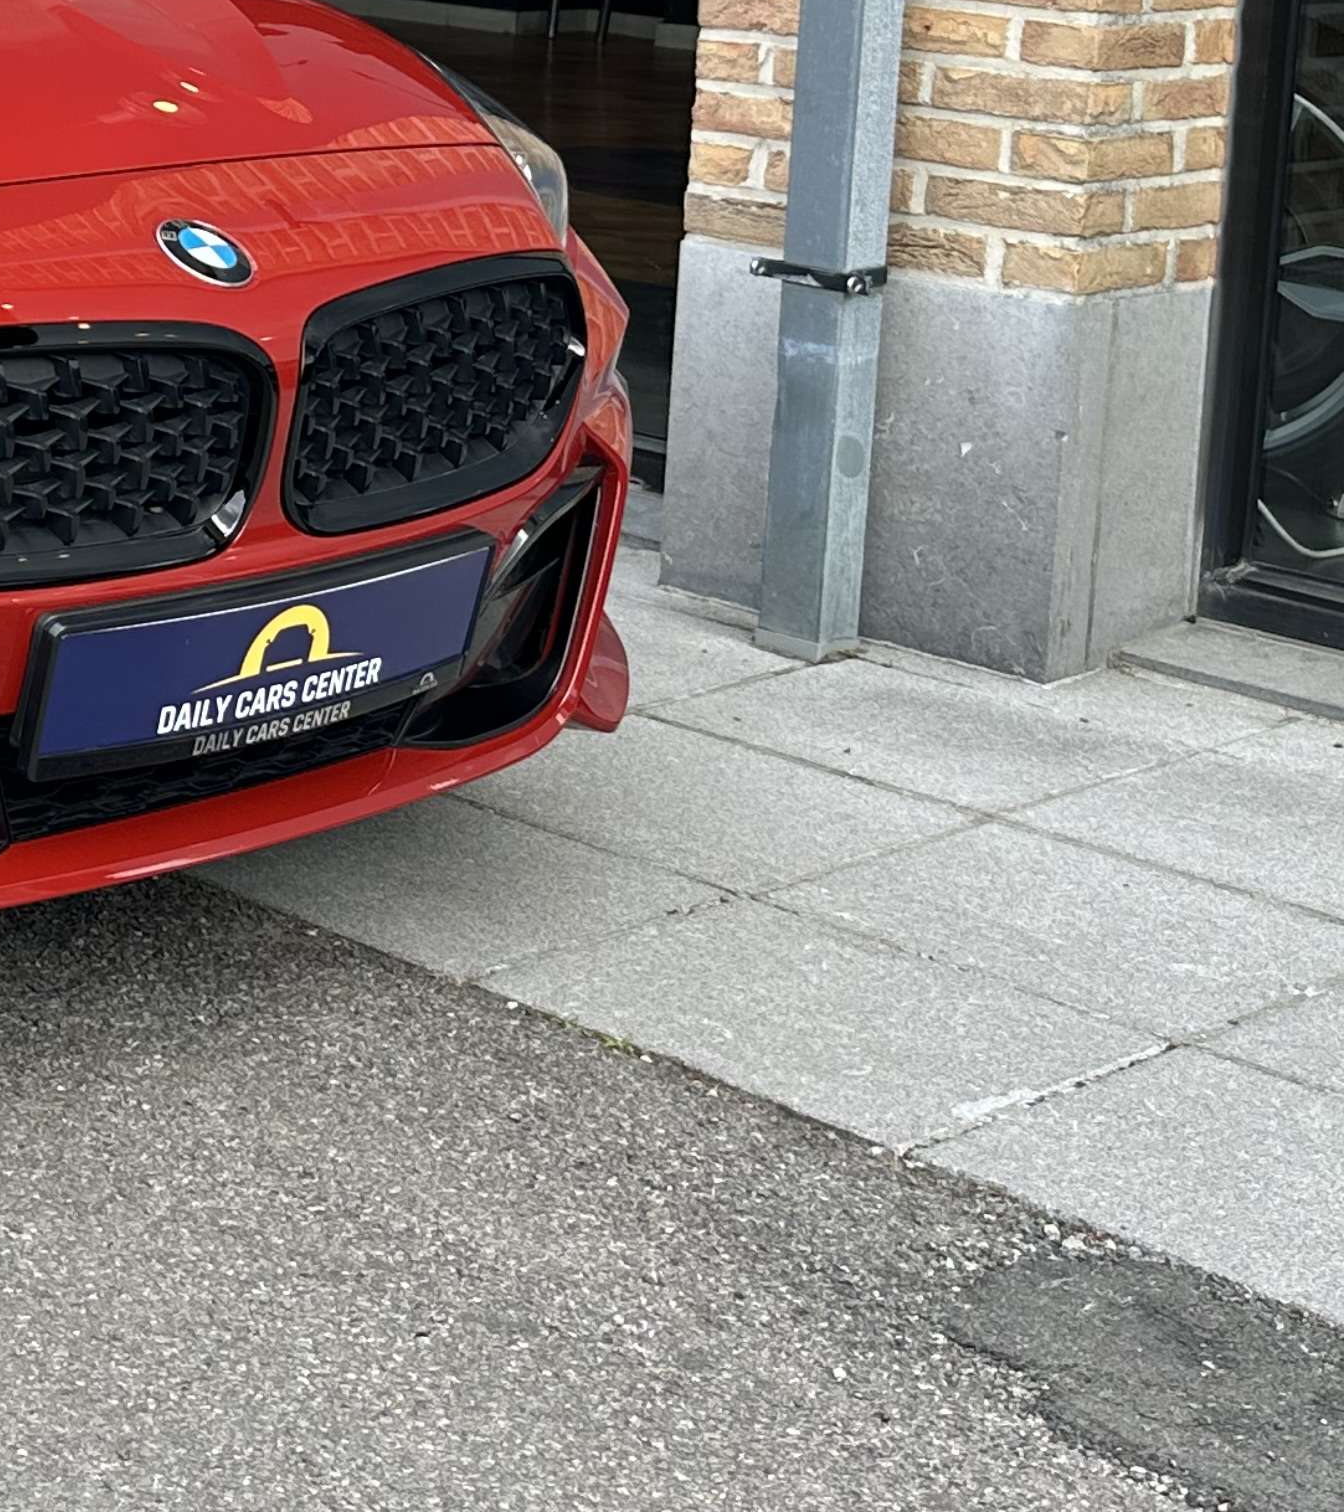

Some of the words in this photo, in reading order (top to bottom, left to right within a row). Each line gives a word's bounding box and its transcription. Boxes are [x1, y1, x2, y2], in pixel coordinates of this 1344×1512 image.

[156, 695, 232, 736] DAILY
[235, 679, 298, 720] CARS
[301, 656, 382, 700] CENTER
[191, 731, 244, 757] DAILY
[245, 719, 291, 745] CARS
[292, 700, 352, 732] CENTER
